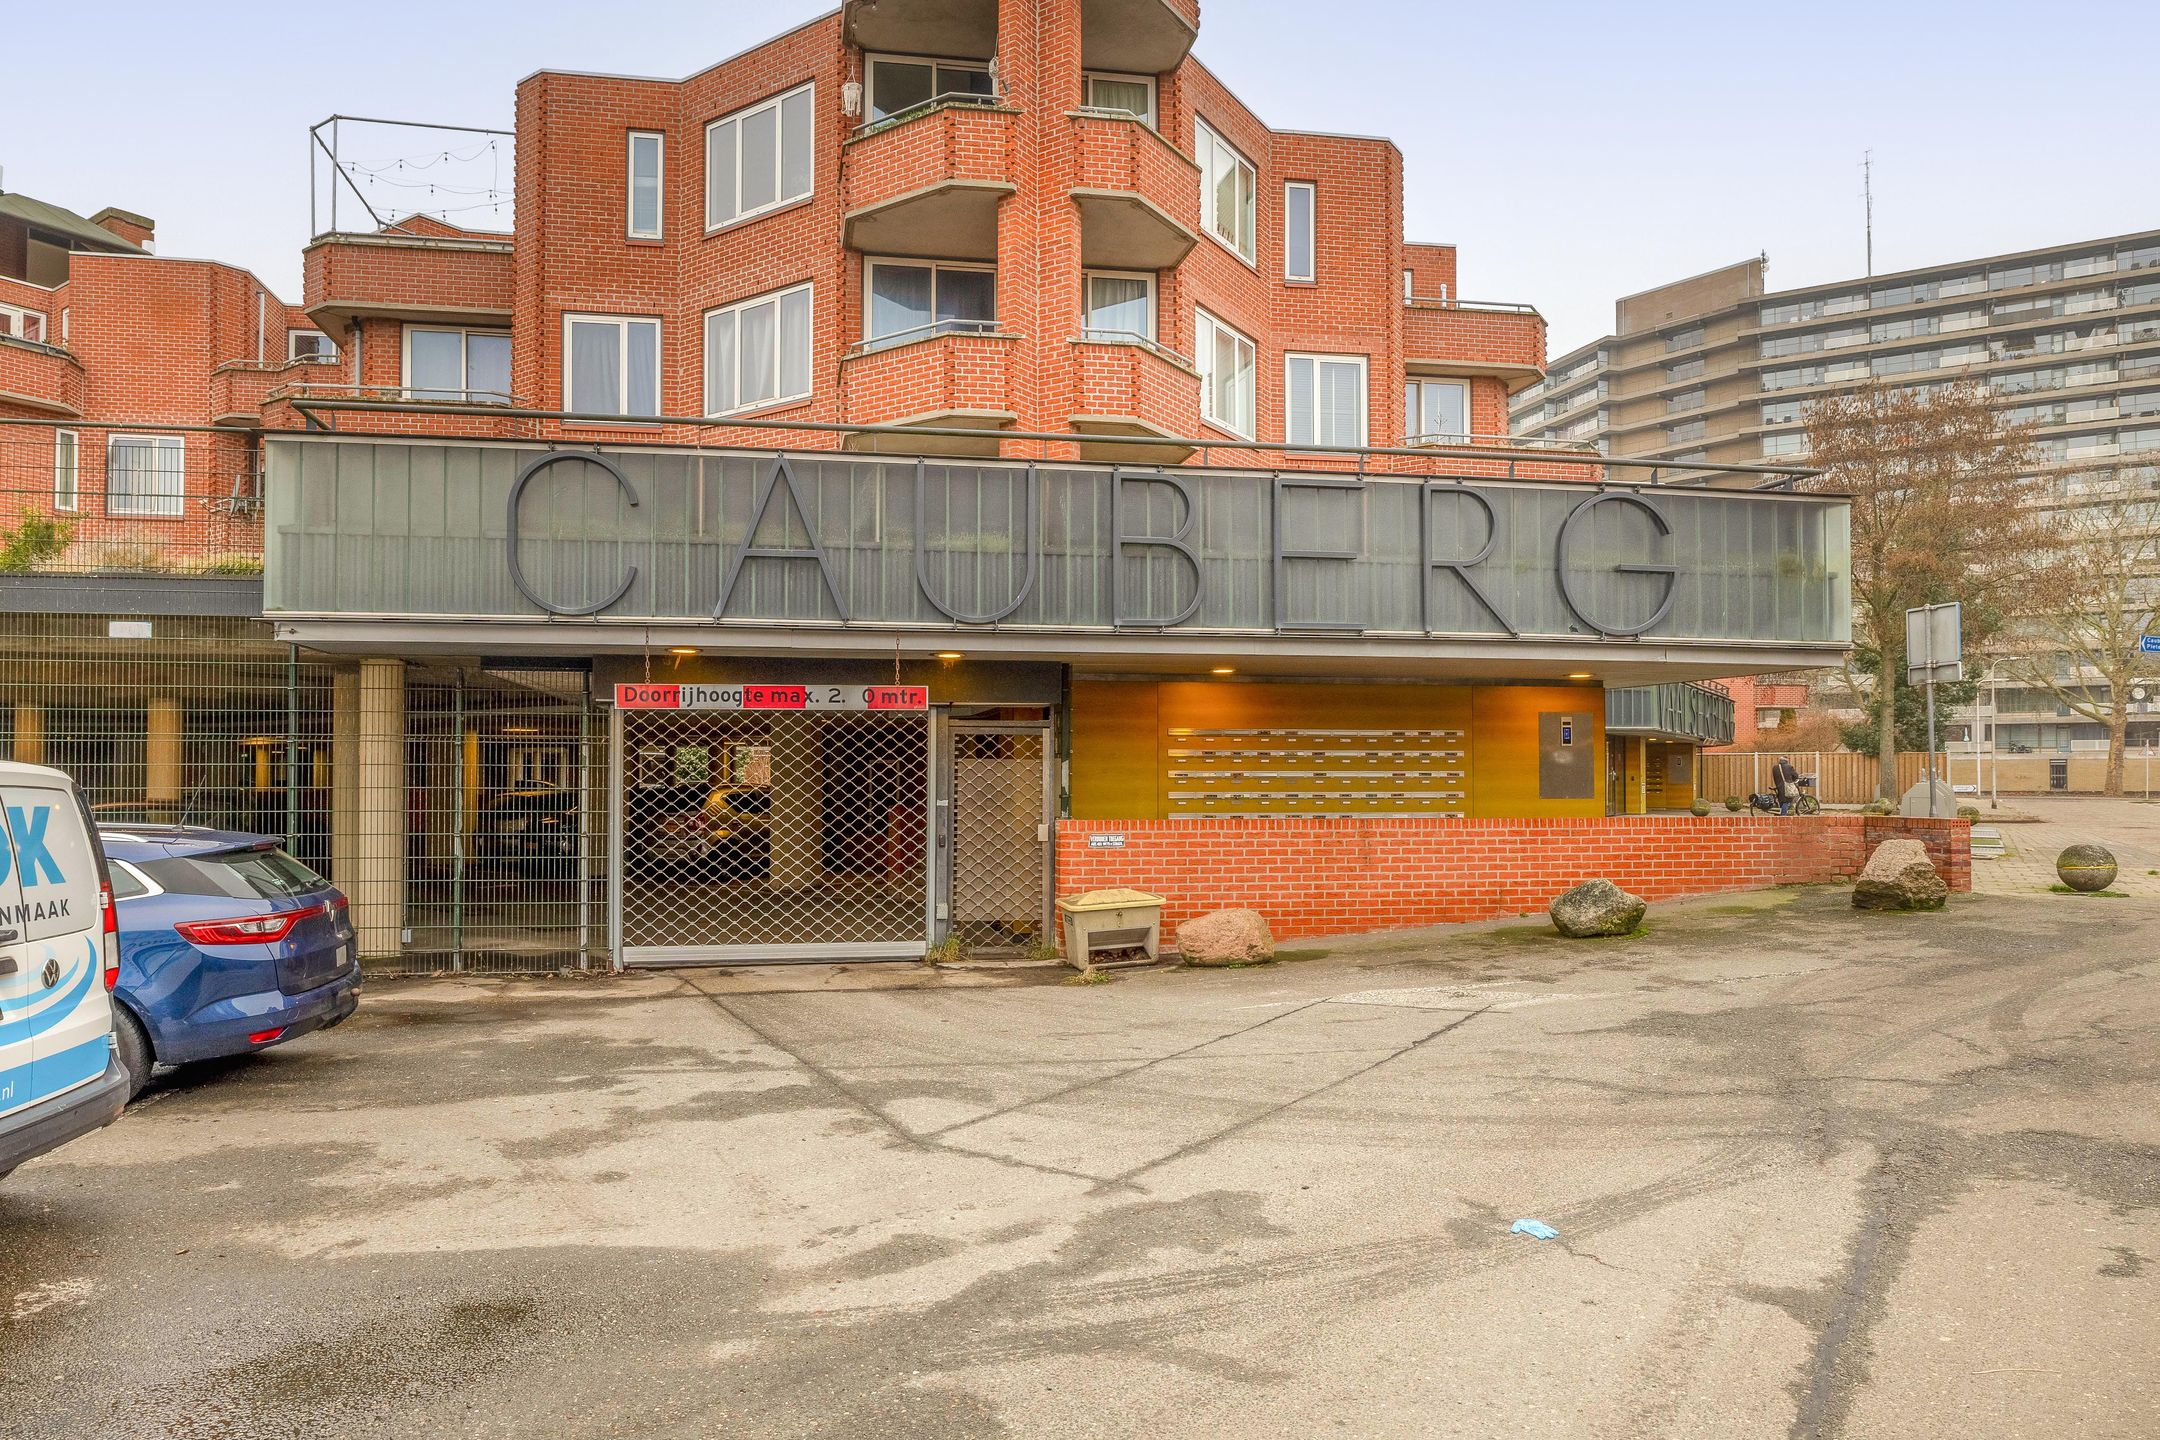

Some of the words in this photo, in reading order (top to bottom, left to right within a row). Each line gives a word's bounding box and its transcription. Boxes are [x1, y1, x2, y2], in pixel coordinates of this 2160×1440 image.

[507, 450, 1680, 637] CAUBERG
[624, 686, 764, 707] Doorrijhoogte
[770, 690, 820, 703] max.
[881, 689, 922, 704] mtr.
